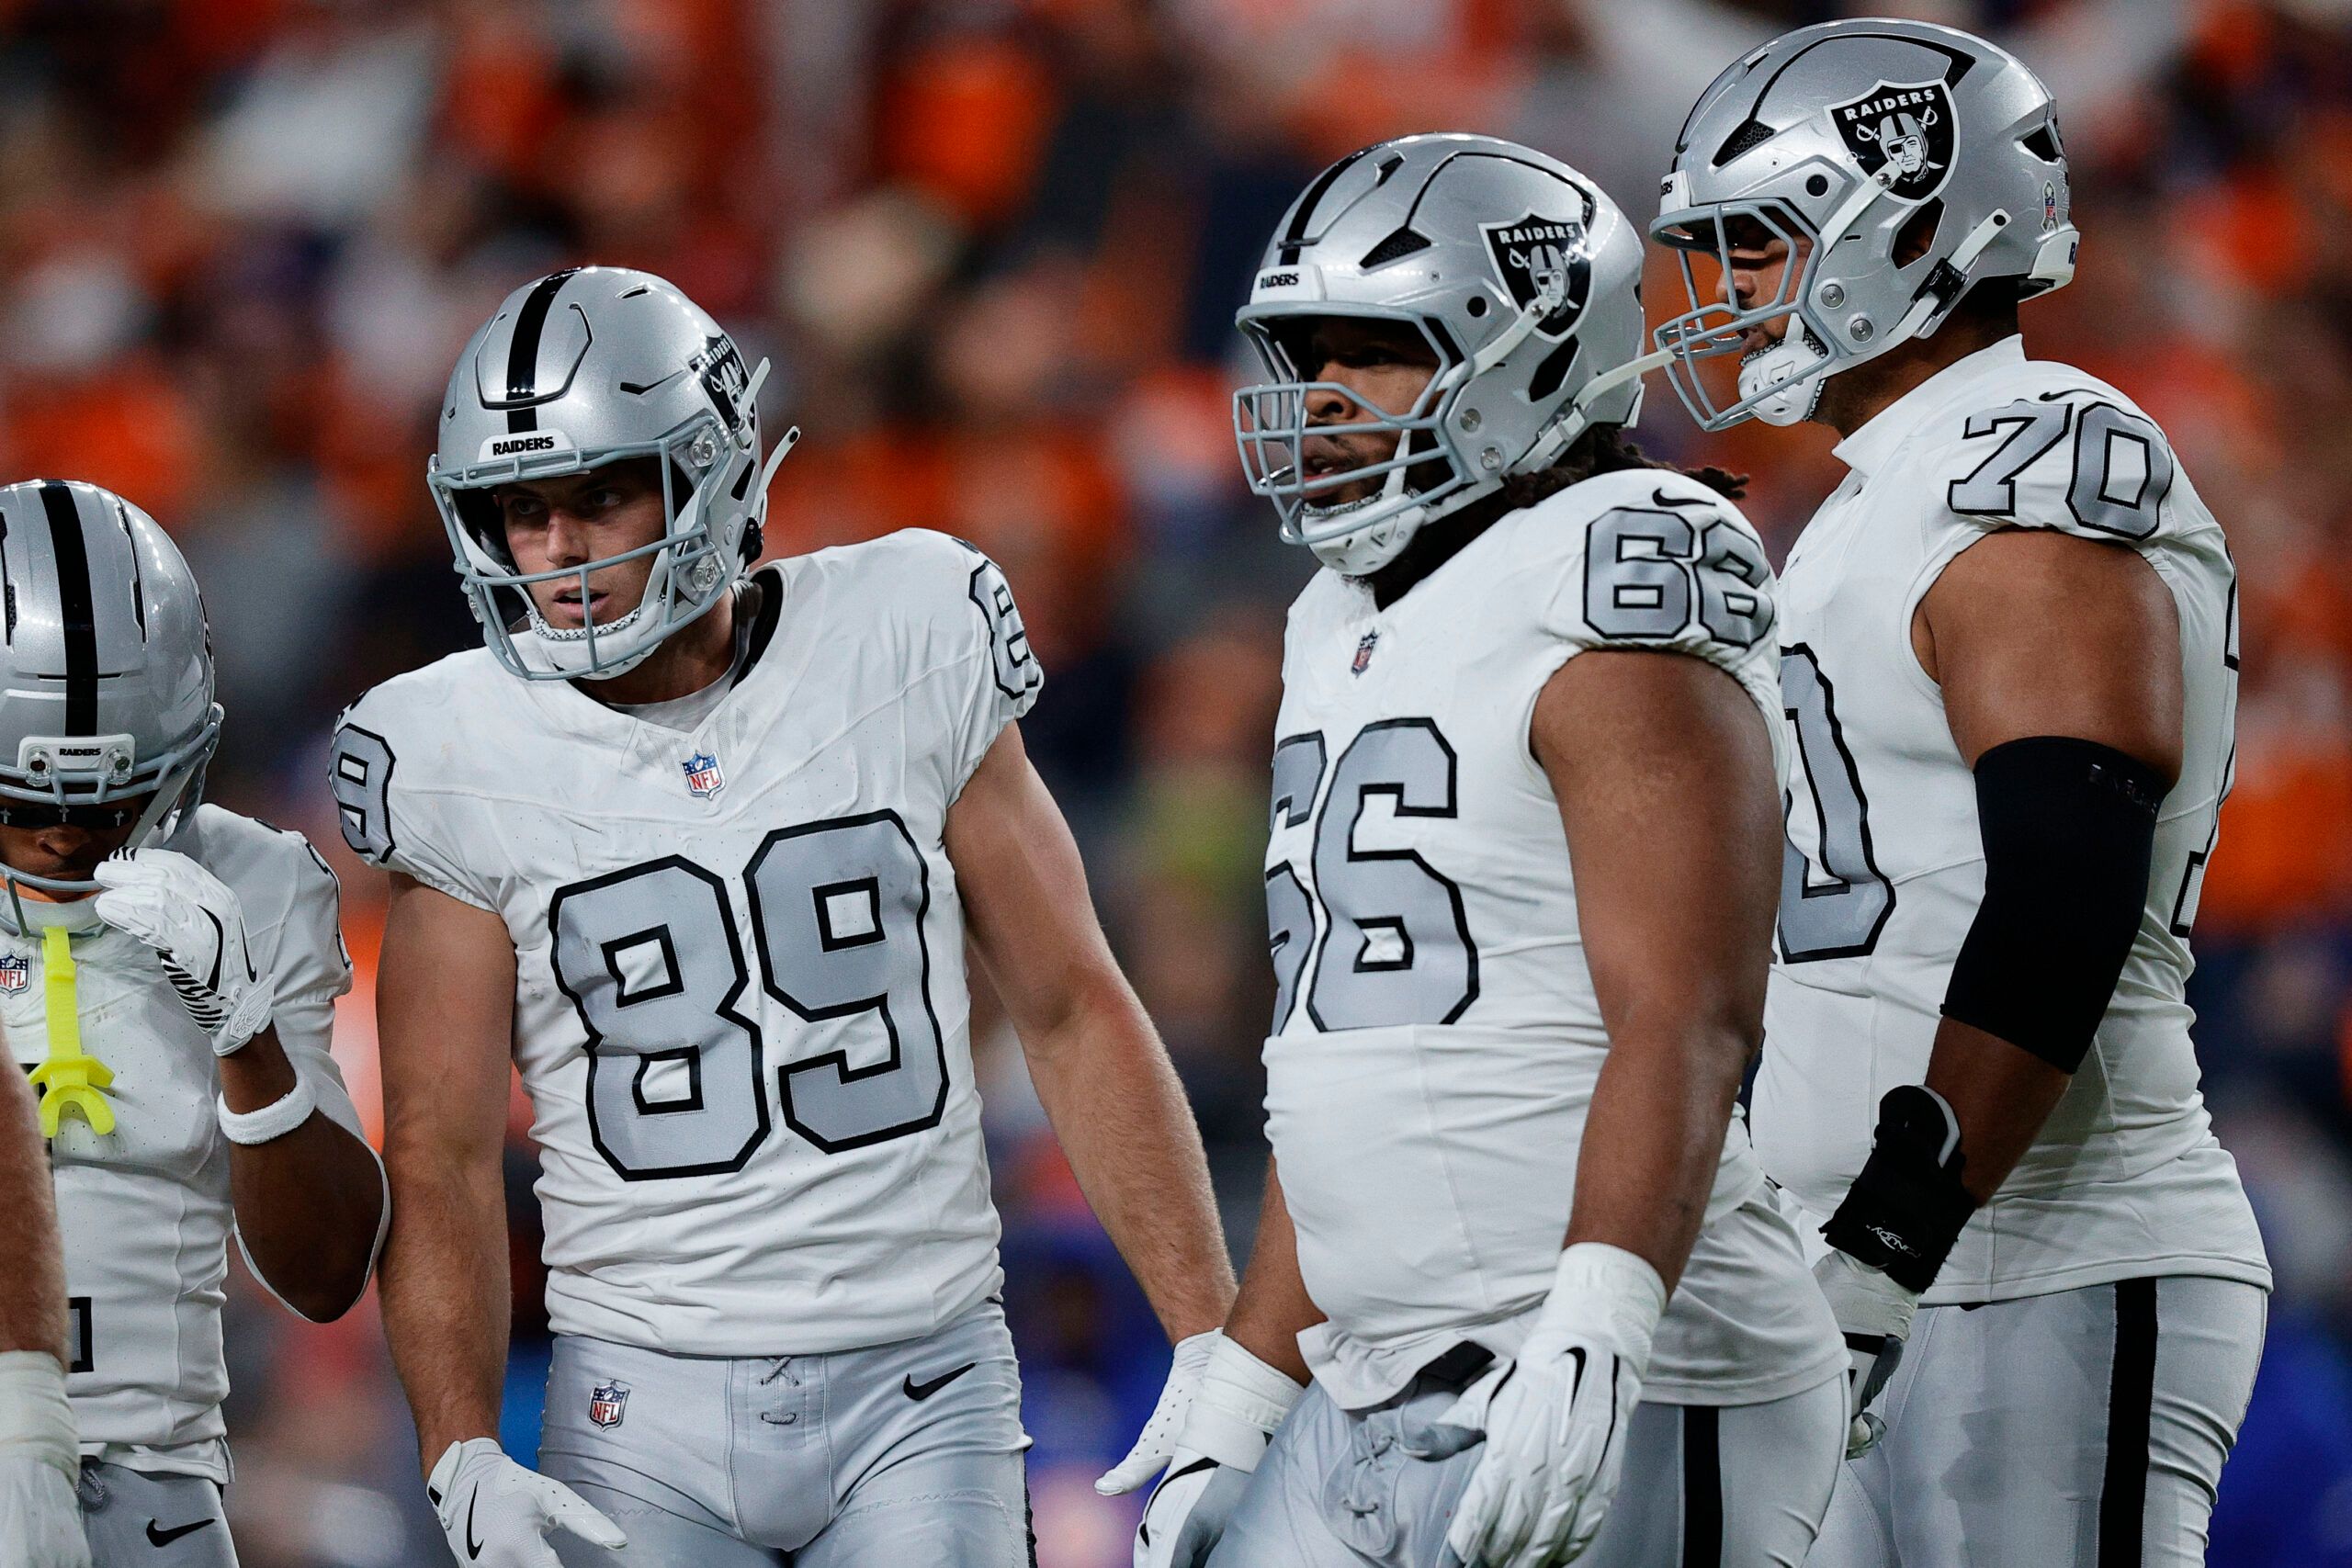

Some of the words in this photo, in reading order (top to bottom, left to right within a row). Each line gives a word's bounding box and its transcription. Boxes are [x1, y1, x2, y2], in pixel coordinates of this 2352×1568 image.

[1843, 88, 1936, 121] RAIDERS
[1498, 224, 1577, 244] RAIDERS
[492, 436, 555, 456] RAIDERS
[1947, 399, 2175, 542] 70
[1582, 506, 1775, 650] 66
[968, 559, 1041, 700] 8
[59, 748, 101, 757] RAIDERS
[328, 721, 397, 863] 9
[689, 770, 720, 791] NFL
[1777, 642, 1897, 964] 0
[0, 969, 25, 988] NFL
[548, 807, 951, 1182] 89
[592, 1401, 617, 1423] NFL
